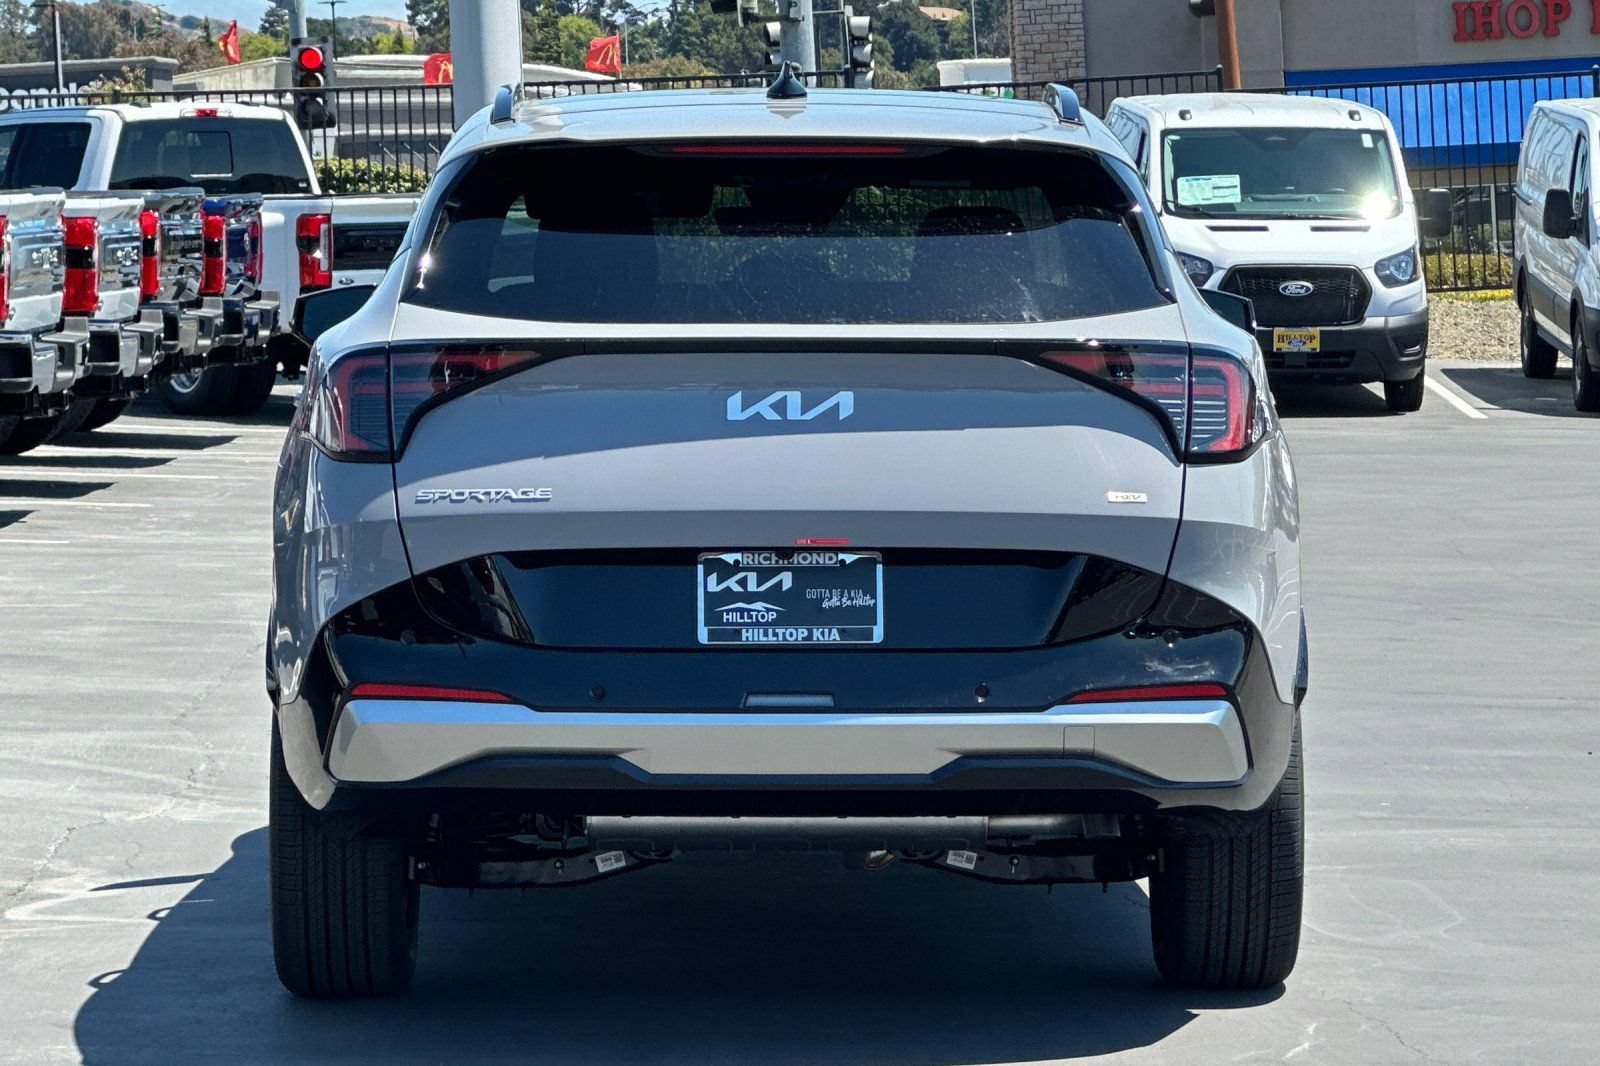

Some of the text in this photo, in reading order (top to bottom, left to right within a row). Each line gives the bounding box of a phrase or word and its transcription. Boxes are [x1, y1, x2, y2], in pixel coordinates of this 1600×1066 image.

[1452, 0, 1572, 42] IHOP
[726, 390, 854, 421] KIA
[415, 487, 552, 503] SPORTAGE
[707, 571, 793, 592] KIA
[806, 588, 830, 599] GOTTA
[832, 588, 841, 600] BE
[850, 588, 864, 599] KIA
[822, 593, 876, 609] Gotta Be Hilltop
[723, 611, 777, 623] HILLTOP
[741, 628, 841, 641] HILLTOP KIA
